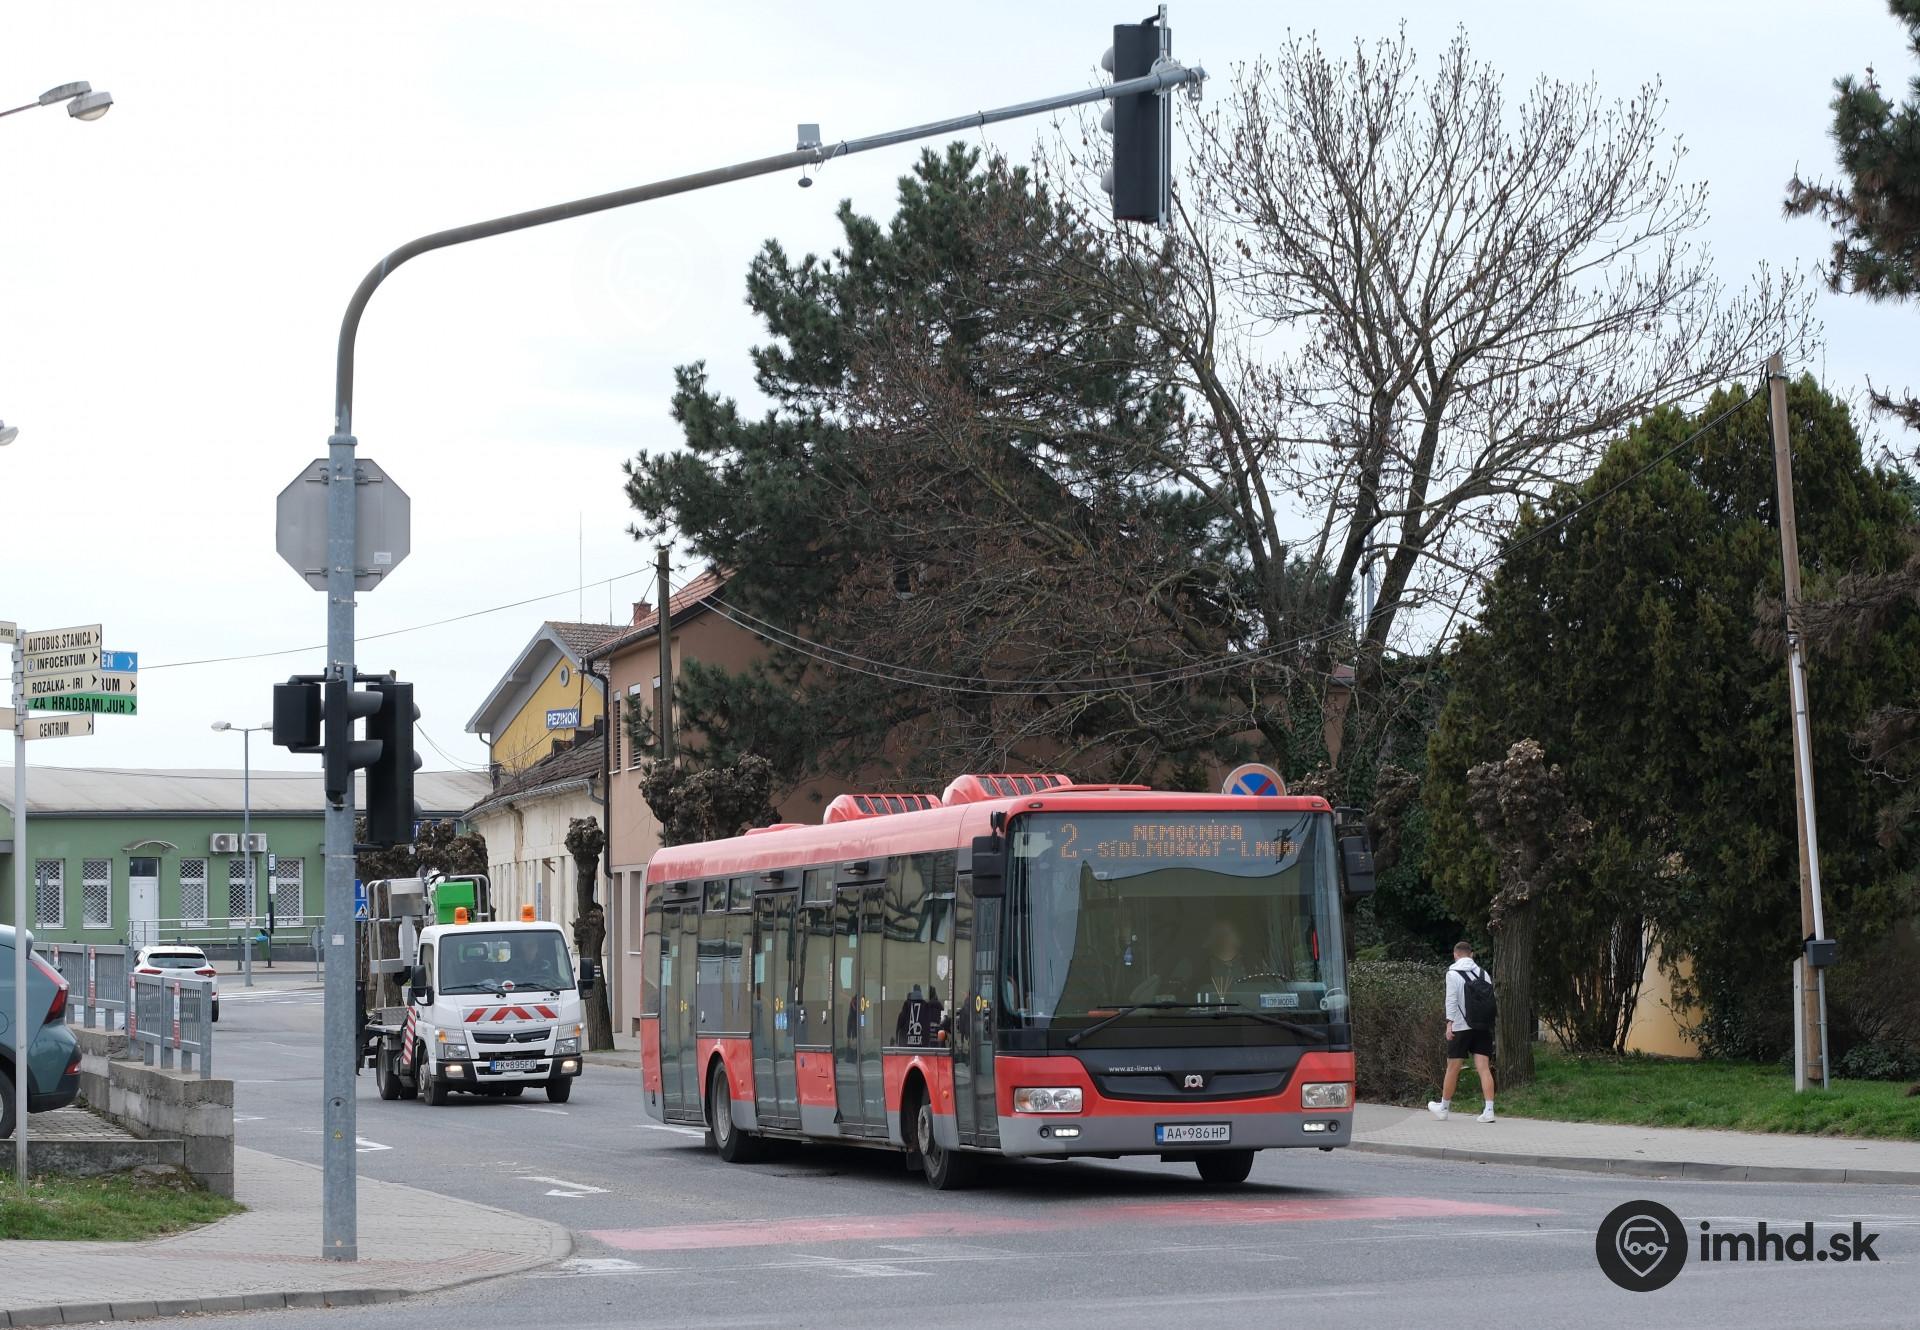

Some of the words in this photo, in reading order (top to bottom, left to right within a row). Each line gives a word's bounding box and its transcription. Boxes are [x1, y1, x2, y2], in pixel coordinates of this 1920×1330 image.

[28, 632, 91, 652] AUTOBUS.STANICA
[37, 654, 86, 670] INFOCENTUM
[73, 677, 83, 690] IRI
[52, 696, 125, 714] HRADBAMI.JUH
[547, 711, 577, 726] PEZINOK
[39, 721, 69, 738] CENTRUM
[1060, 823, 1078, 858] 2
[1132, 824, 1242, 841] NEMOCNICA
[495, 1061, 506, 1070] PK
[1108, 1065, 1162, 1073] www.az-lines.sk
[1167, 1127, 1182, 1139] AA
